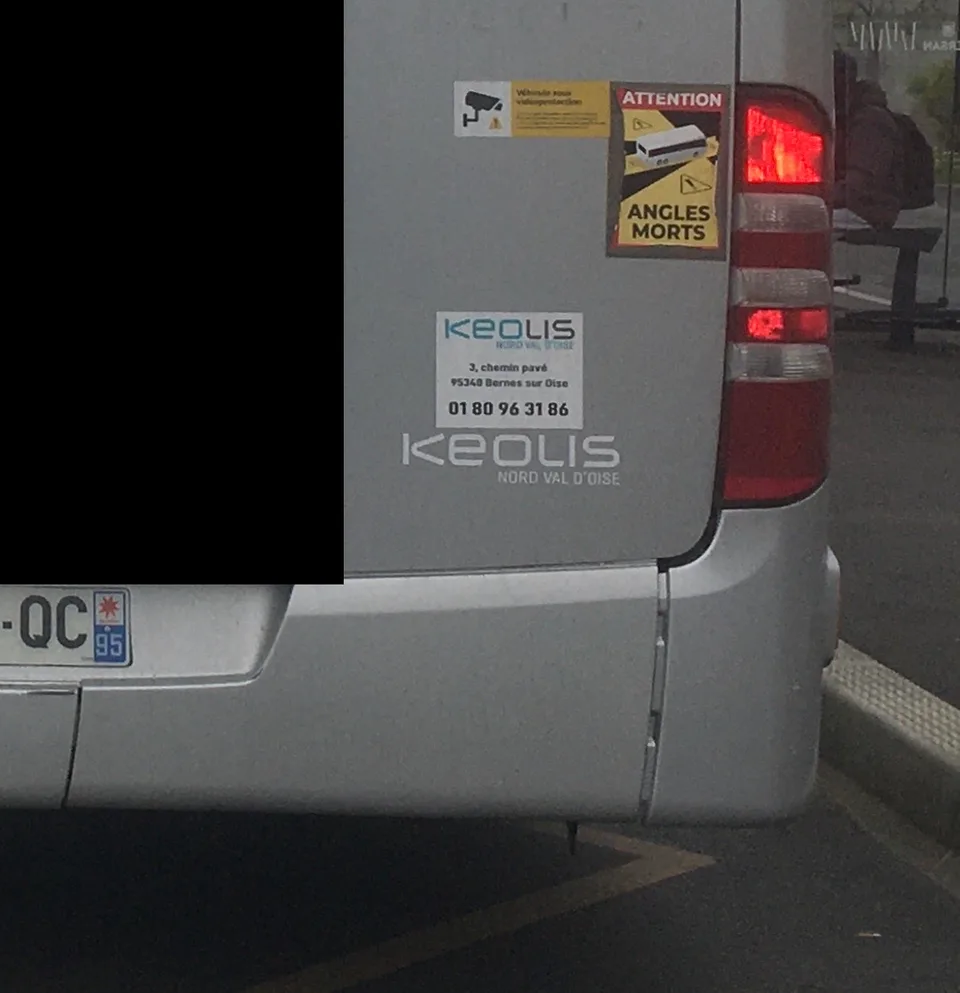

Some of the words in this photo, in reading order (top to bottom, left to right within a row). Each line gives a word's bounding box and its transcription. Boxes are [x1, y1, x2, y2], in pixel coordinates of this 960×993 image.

[622, 91, 722, 107] ATTENTION
[627, 204, 711, 222] ANGLES
[631, 223, 706, 241] MORTS
[480, 363, 519, 372] chemin
[521, 363, 548, 374] pavé
[485, 378, 522, 387] Bernes
[525, 379, 543, 387] sur
[544, 379, 569, 388] Oise
[448, 401, 467, 415] 01
[472, 401, 494, 416] 80
[498, 402, 520, 416] 96
[524, 402, 543, 416] 31
[547, 402, 569, 417] 86
[498, 470, 539, 485] NORD
[542, 471, 570, 486] VAL
[572, 471, 621, 487] D'OISE
[95, 633, 123, 657] 95
